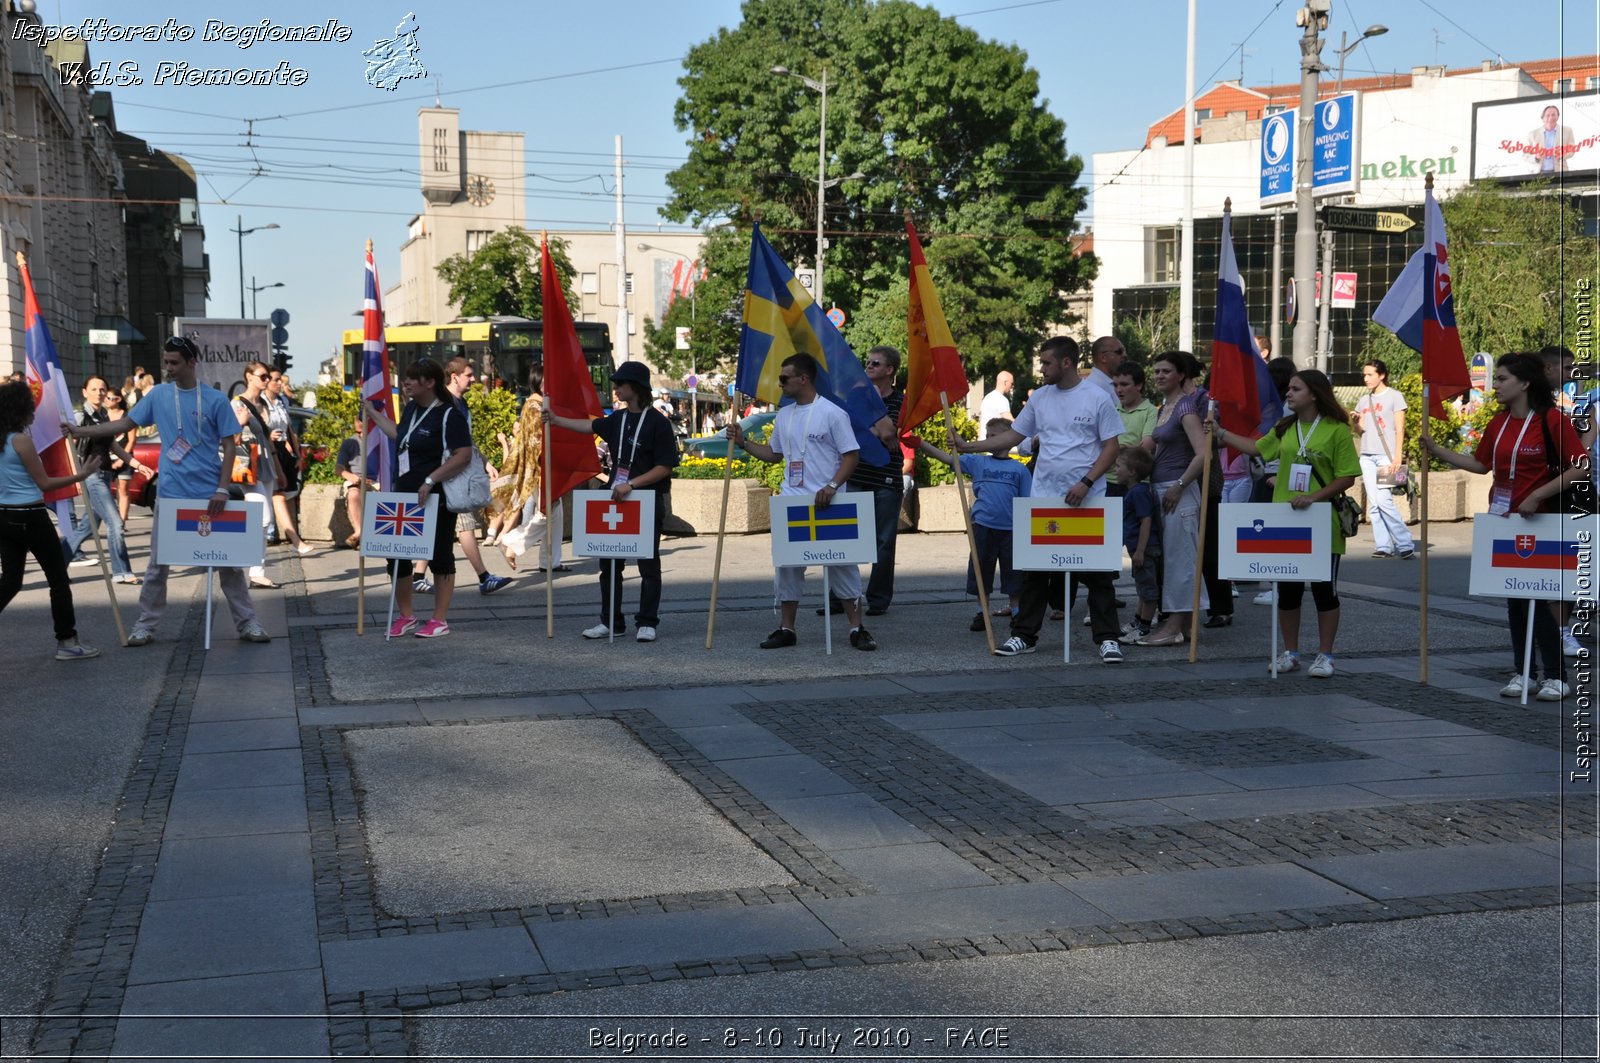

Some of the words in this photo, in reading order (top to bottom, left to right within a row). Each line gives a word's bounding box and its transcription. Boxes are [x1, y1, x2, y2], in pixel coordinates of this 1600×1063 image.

[1344, 212, 1392, 229] SMEDEREVO
[196, 344, 260, 363] MaxMara
[365, 541, 391, 553] United
[393, 543, 429, 556] Kingdom
[587, 541, 638, 554] Switzerland
[803, 549, 846, 561] Sweden
[192, 549, 228, 562] Serbia
[1051, 553, 1084, 568] Spain
[1249, 562, 1299, 575] Slovenia
[1504, 577, 1561, 593] Slovakia
